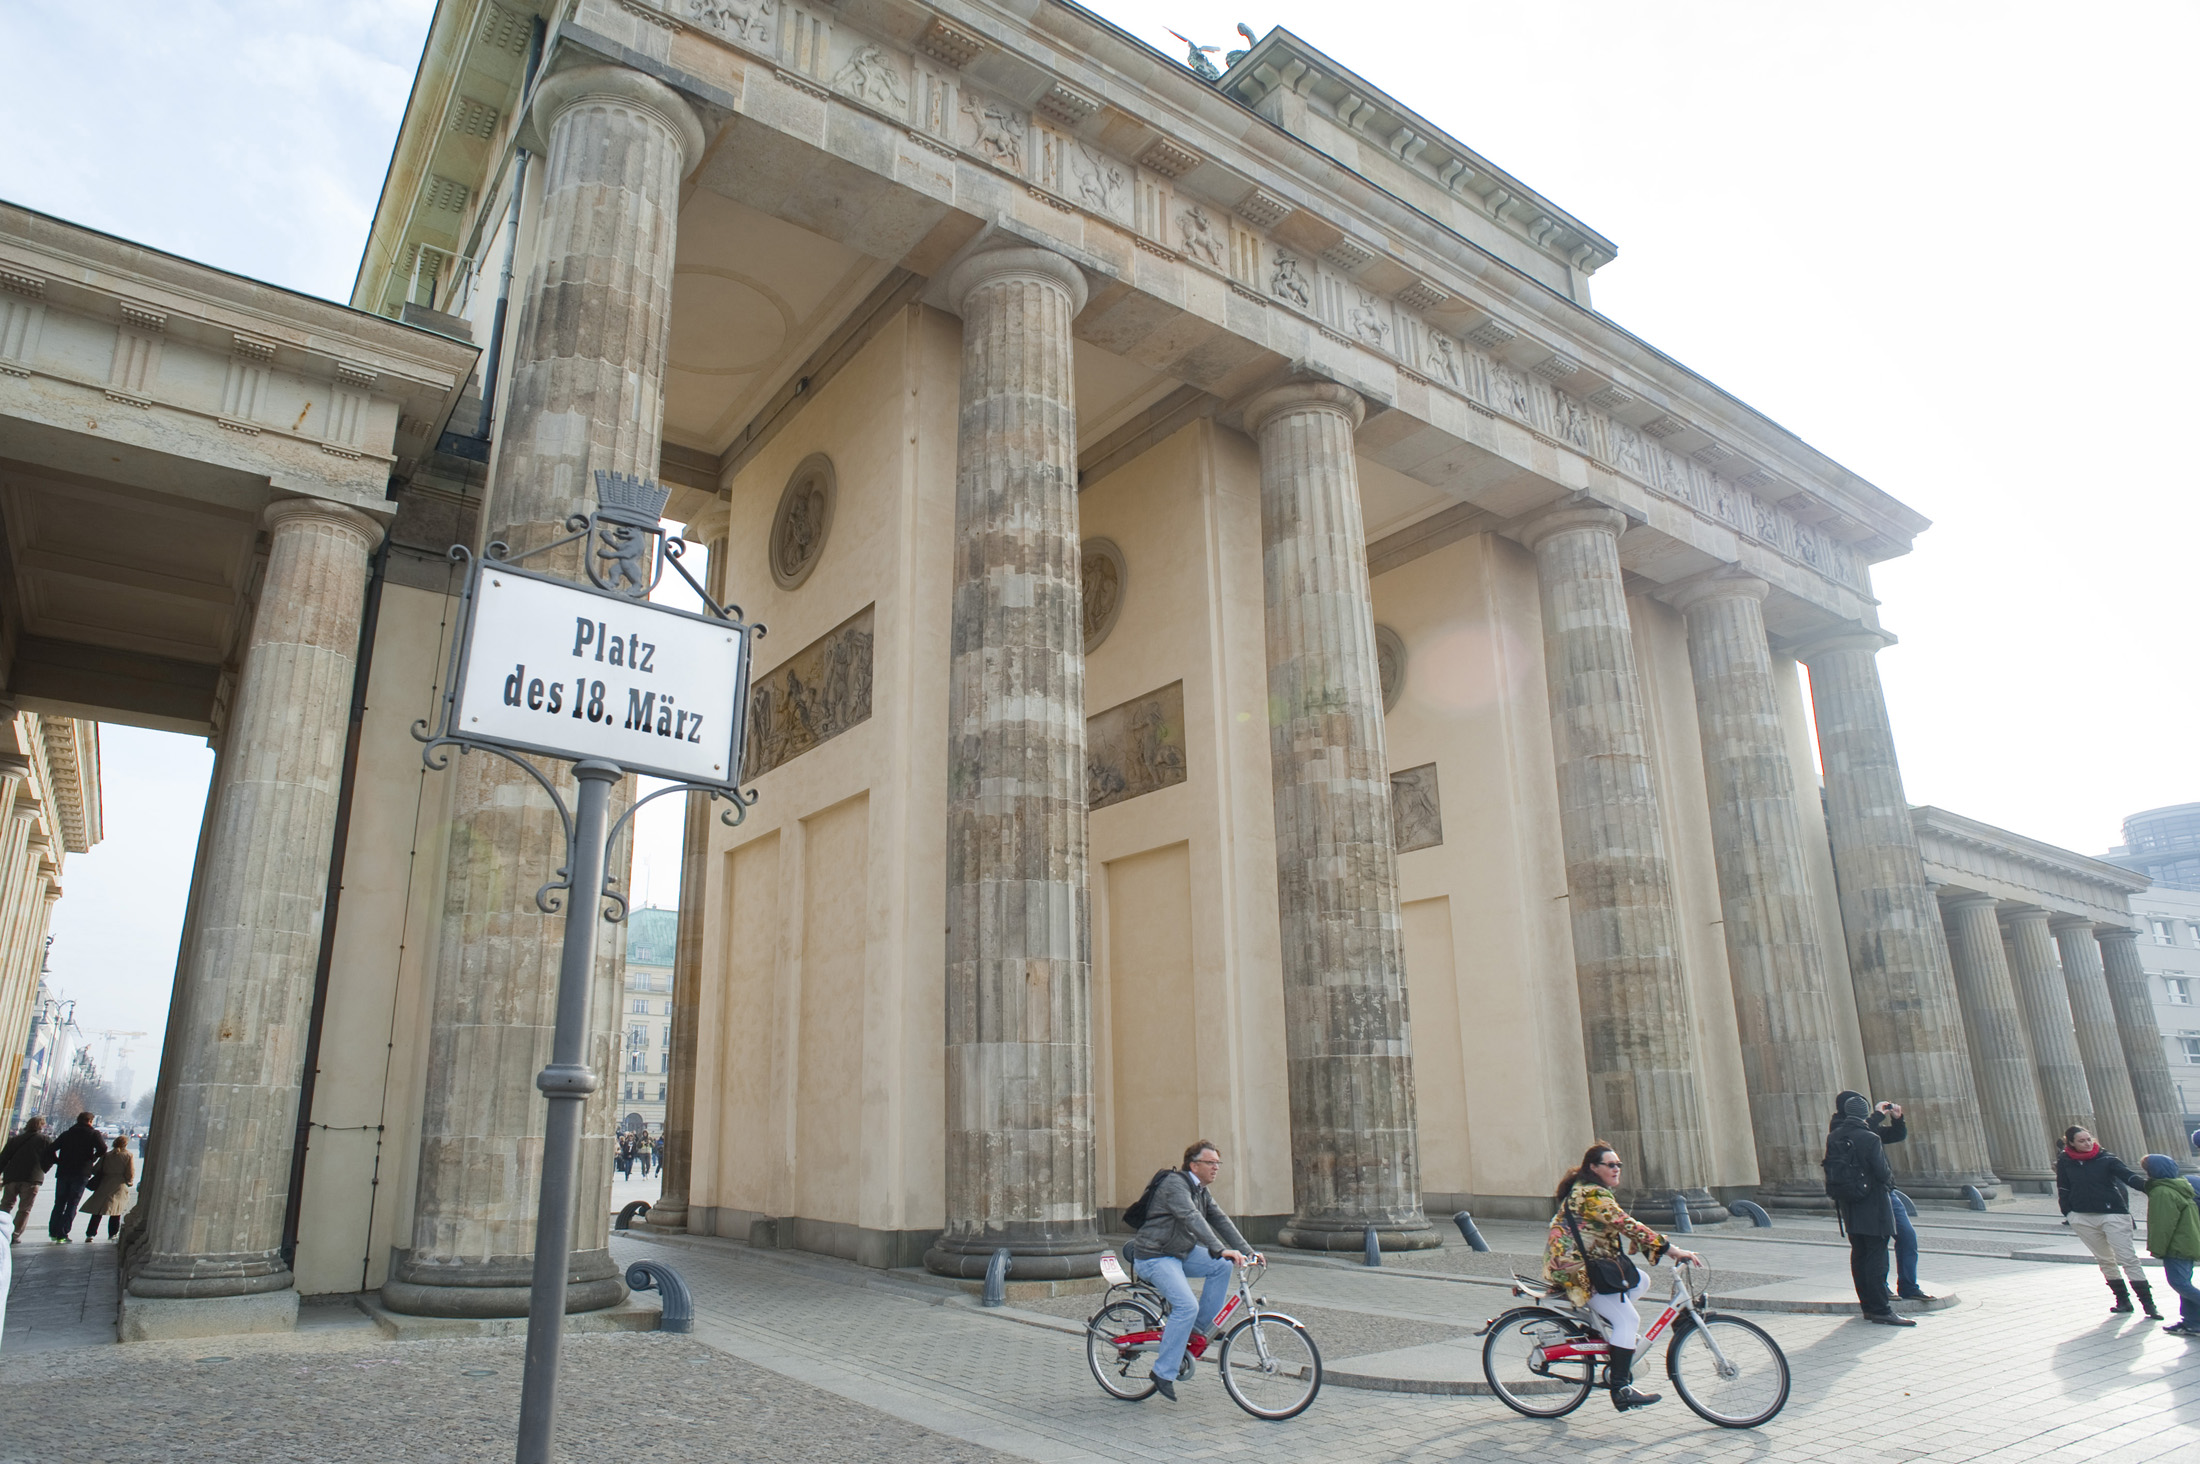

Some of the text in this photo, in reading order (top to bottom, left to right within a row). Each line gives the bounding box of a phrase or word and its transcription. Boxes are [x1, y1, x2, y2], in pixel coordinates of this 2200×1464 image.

[572, 616, 656, 674] Platz
[503, 663, 704, 744] des 18. März
